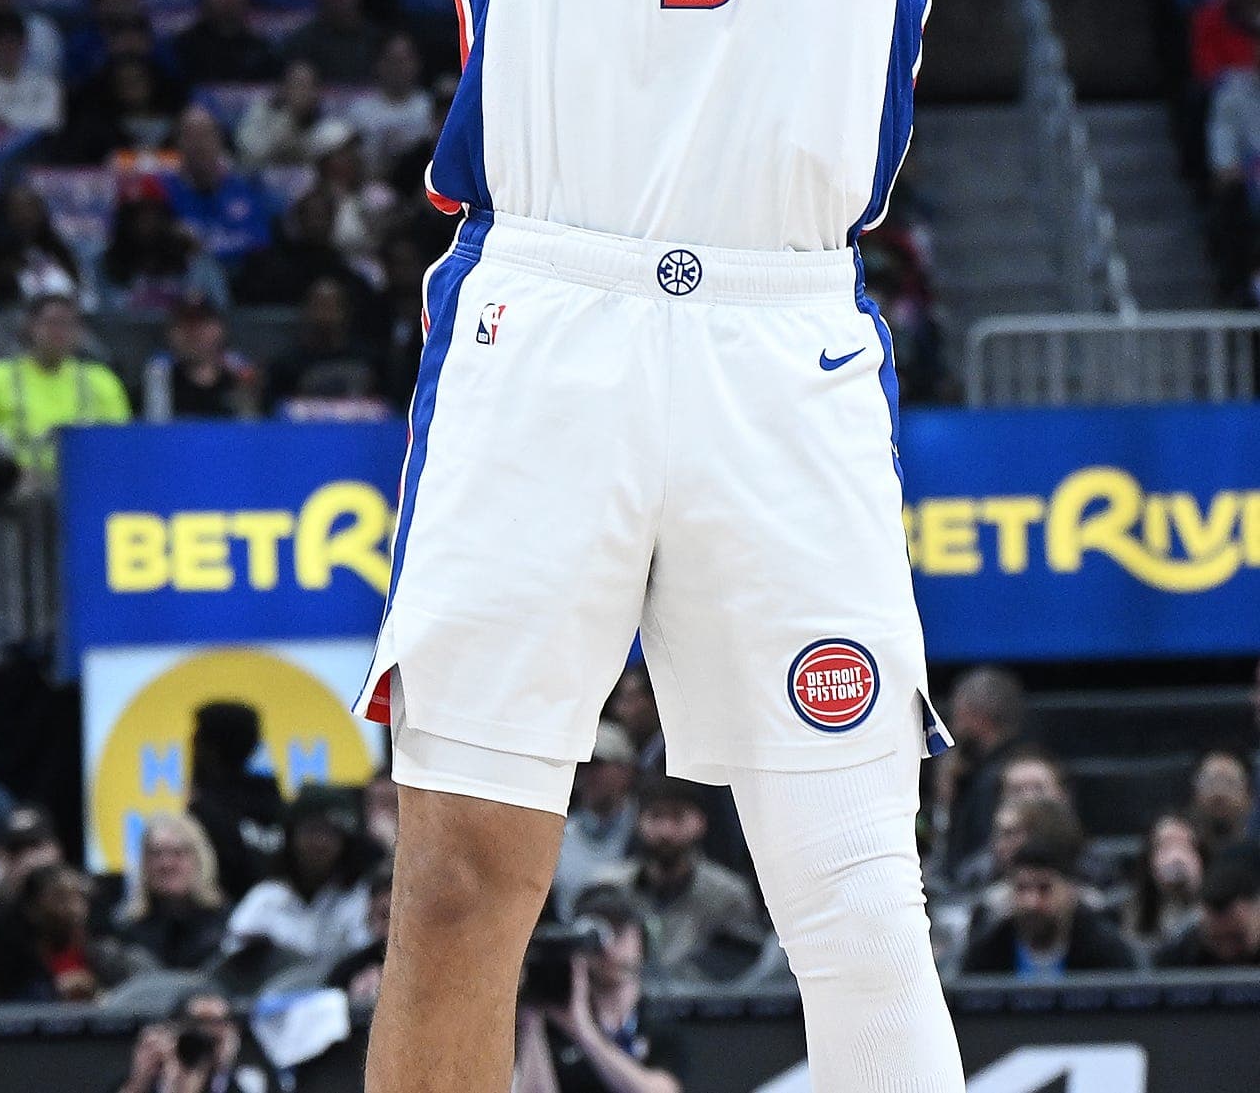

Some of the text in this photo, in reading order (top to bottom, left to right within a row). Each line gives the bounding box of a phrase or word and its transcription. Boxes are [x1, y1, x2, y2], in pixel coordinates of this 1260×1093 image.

[105, 481, 397, 596] BETR
[902, 467, 1260, 592] ETRIV
[804, 666, 862, 687] DETROIT
[805, 681, 864, 703] PISTONS
